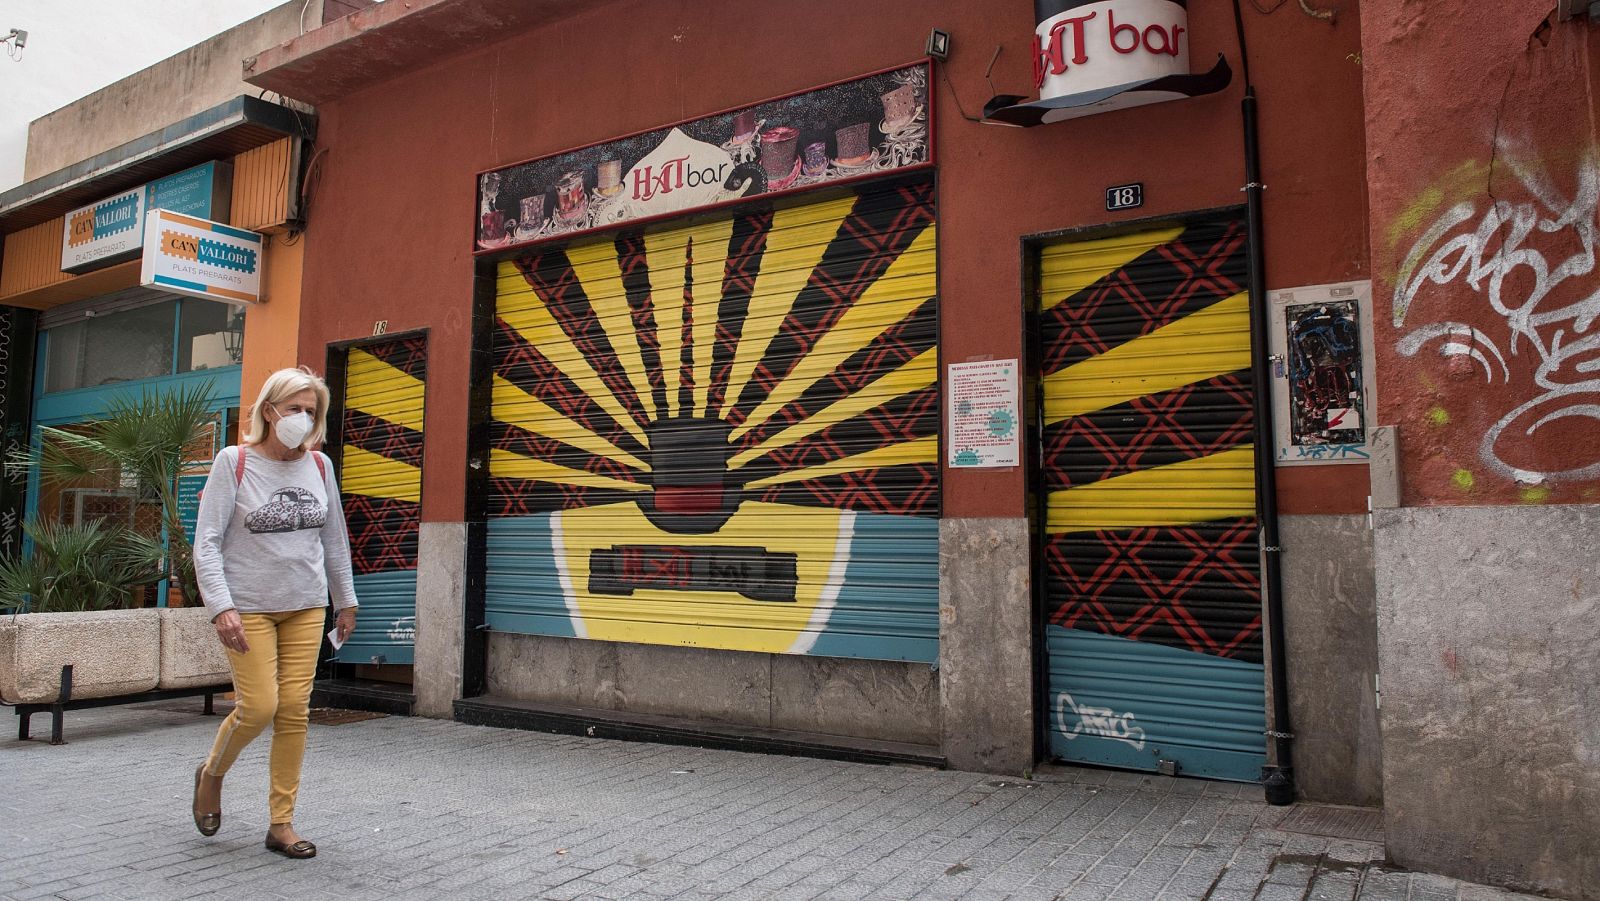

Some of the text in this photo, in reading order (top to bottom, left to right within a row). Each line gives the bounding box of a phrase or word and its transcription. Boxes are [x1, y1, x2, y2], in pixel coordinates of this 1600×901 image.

[1108, 9, 1185, 57] bar
[632, 154, 728, 201] HAT bar
[1113, 188, 1134, 206] 18
[95, 205, 132, 229] VALLORI
[75, 240, 126, 262] PLATS PREPARATS
[171, 238, 248, 265] CA'N VALLORI
[172, 263, 242, 285] PLATS PREPARATS
[375, 321, 387, 335] 18
